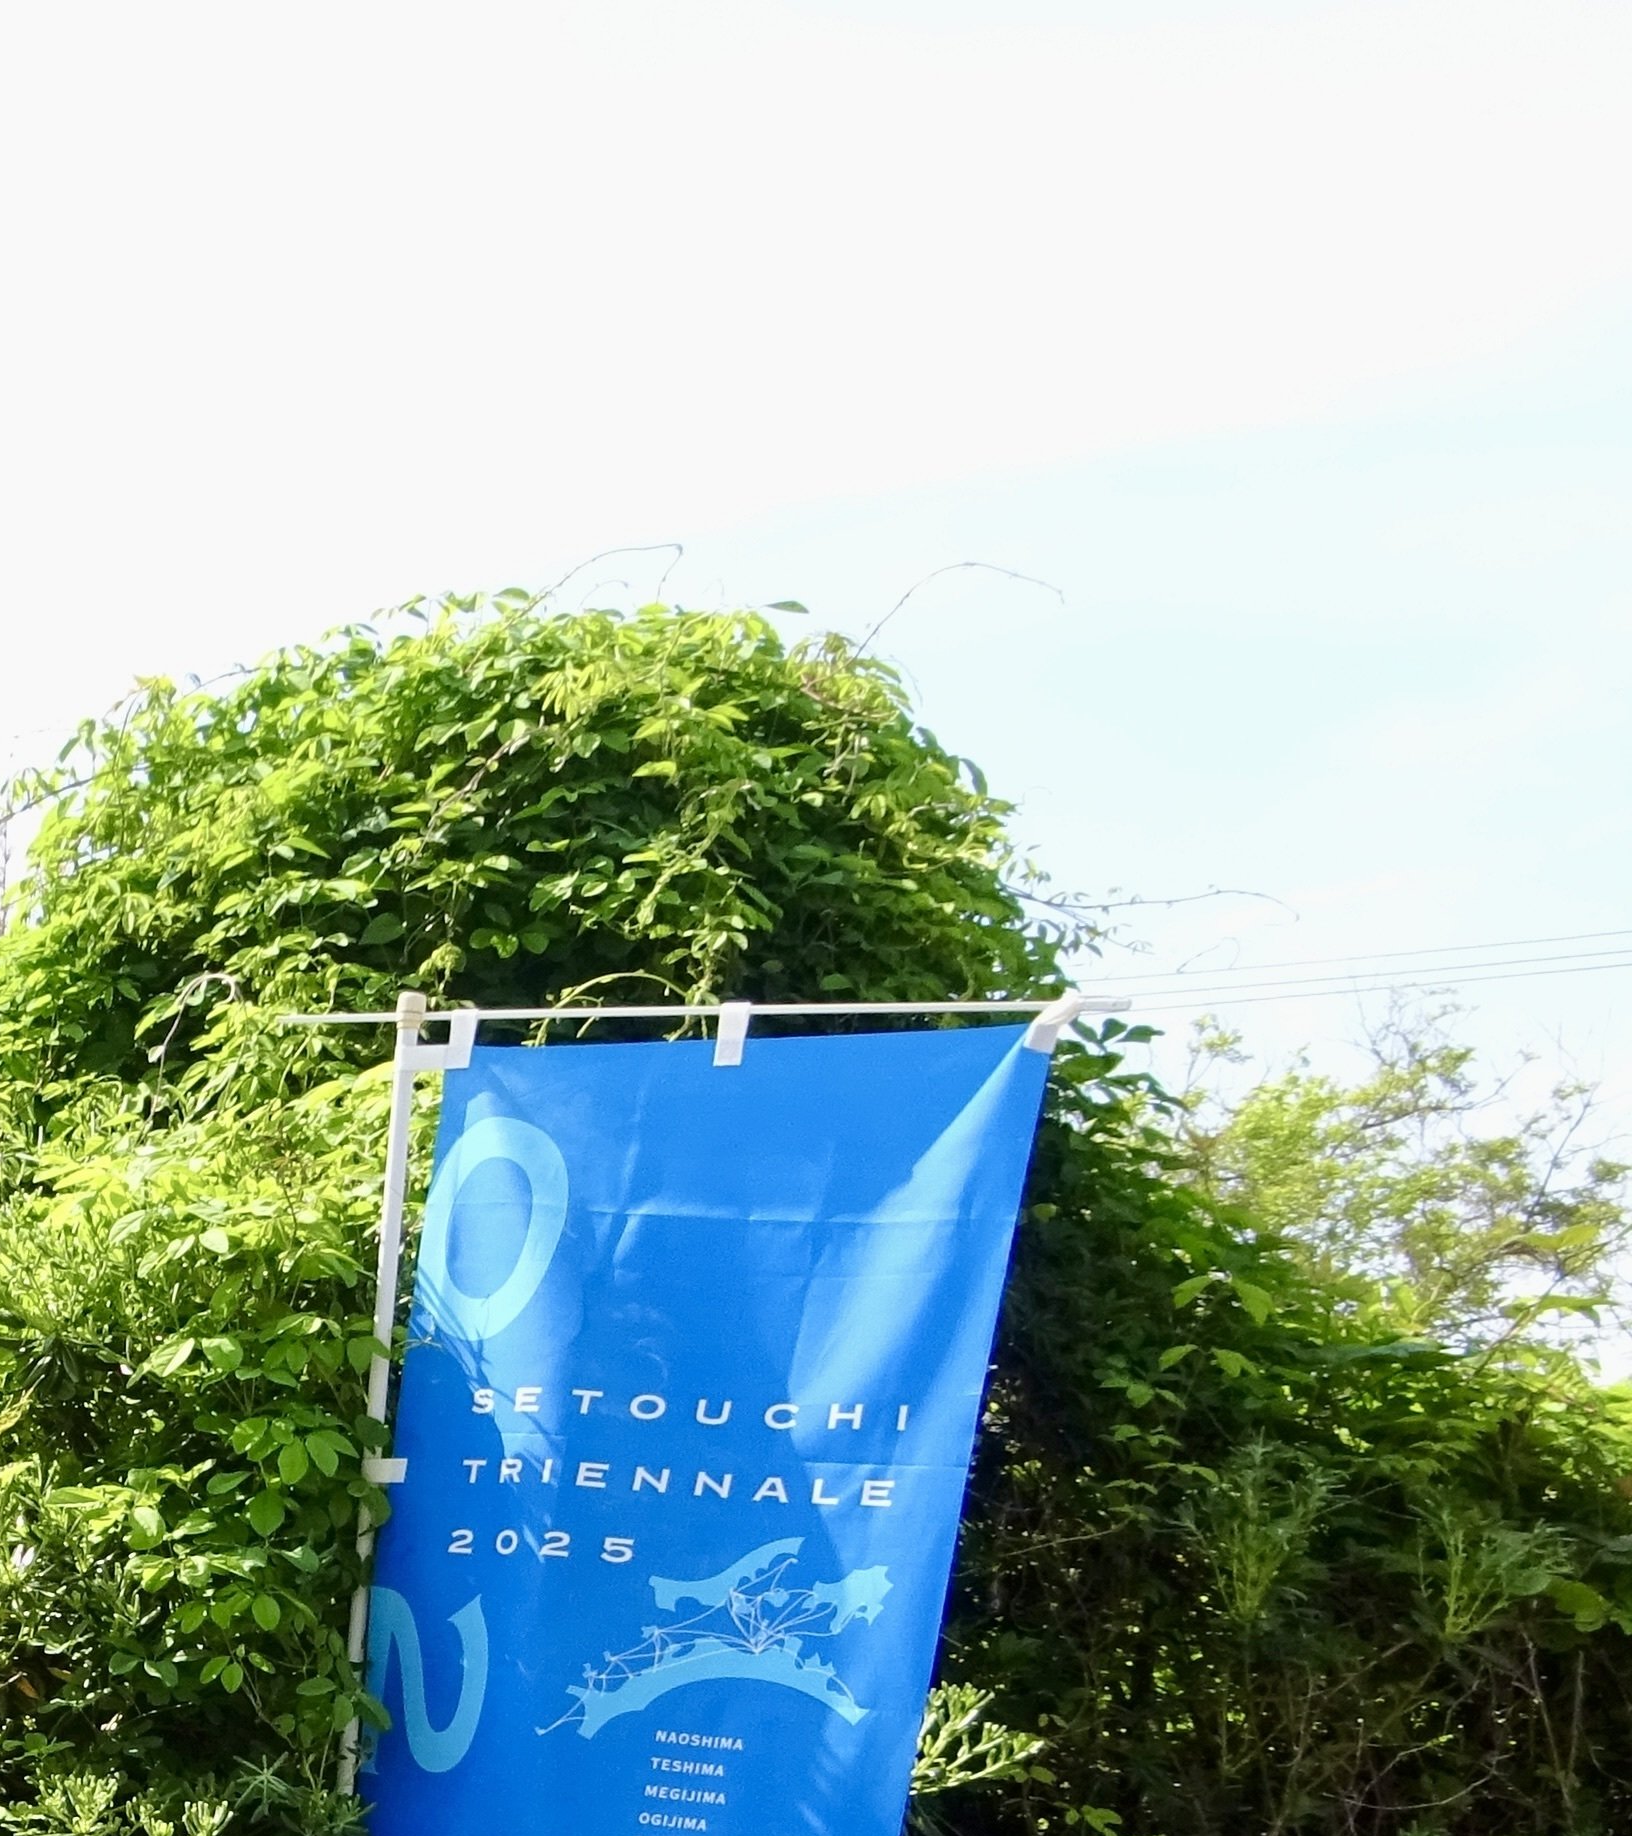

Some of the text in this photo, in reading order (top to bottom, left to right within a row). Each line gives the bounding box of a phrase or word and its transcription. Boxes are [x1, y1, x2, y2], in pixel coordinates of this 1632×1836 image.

[471, 1386, 910, 1432] SETOUCHI
[462, 1458, 896, 1508] TRIENNALE
[448, 1528, 636, 1565] 2025
[656, 1731, 743, 1751] NAOSHIMA
[651, 1757, 724, 1777] TESHIMA
[644, 1785, 726, 1805] MEGIJIMA
[638, 1812, 707, 1831] OGIJIMA
